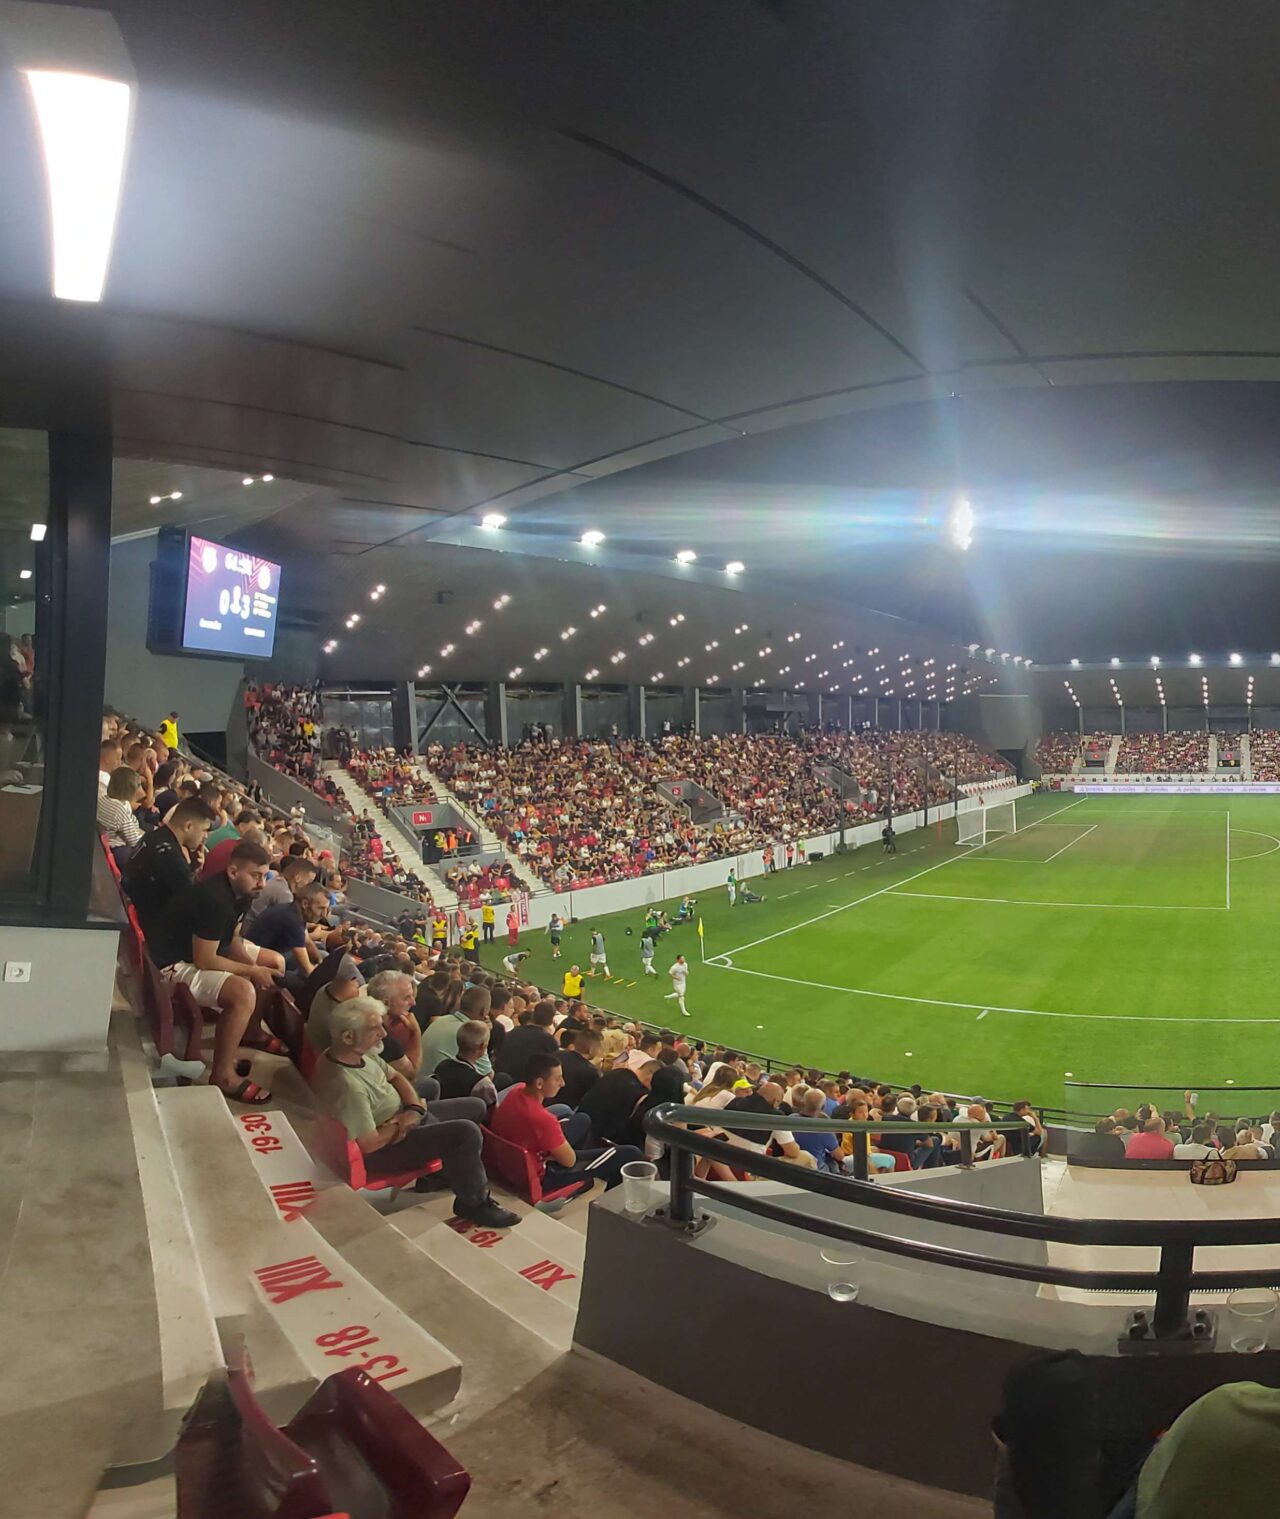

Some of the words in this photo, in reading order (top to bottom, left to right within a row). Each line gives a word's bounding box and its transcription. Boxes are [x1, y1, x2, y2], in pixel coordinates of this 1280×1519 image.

[240, 1113, 284, 1155] 19-30
[269, 1181, 318, 1222] XIII
[253, 1255, 344, 1304] XIII
[518, 1259, 577, 1292] XII
